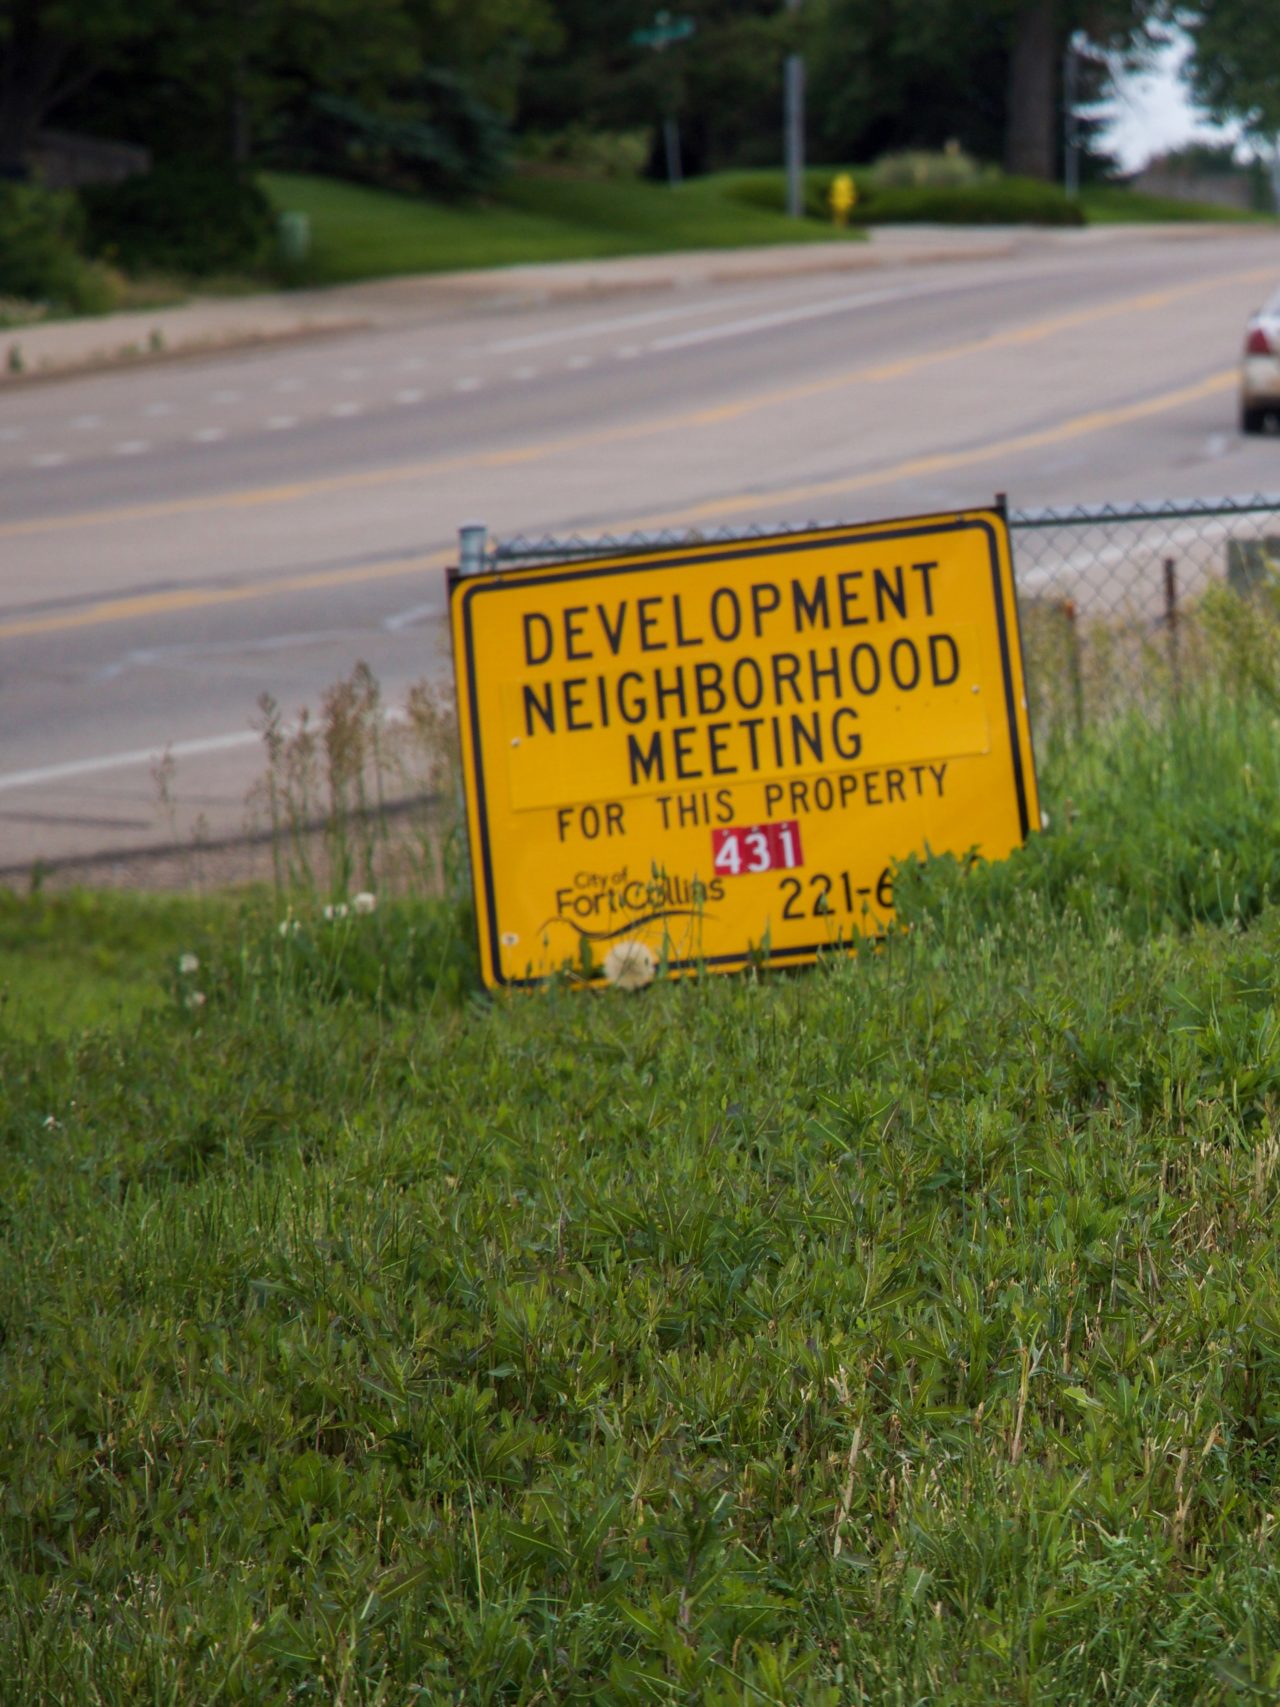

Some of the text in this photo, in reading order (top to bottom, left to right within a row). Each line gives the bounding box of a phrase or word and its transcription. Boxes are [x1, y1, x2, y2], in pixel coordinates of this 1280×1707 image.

[522, 561, 939, 667] DEVELOPMENT
[521, 633, 961, 737] NEIGHBORHOOD
[627, 706, 863, 786] MEETING
[556, 763, 949, 843] FOR THIS PROPERTY
[573, 864, 629, 891] City of
[714, 829, 796, 875] 431
